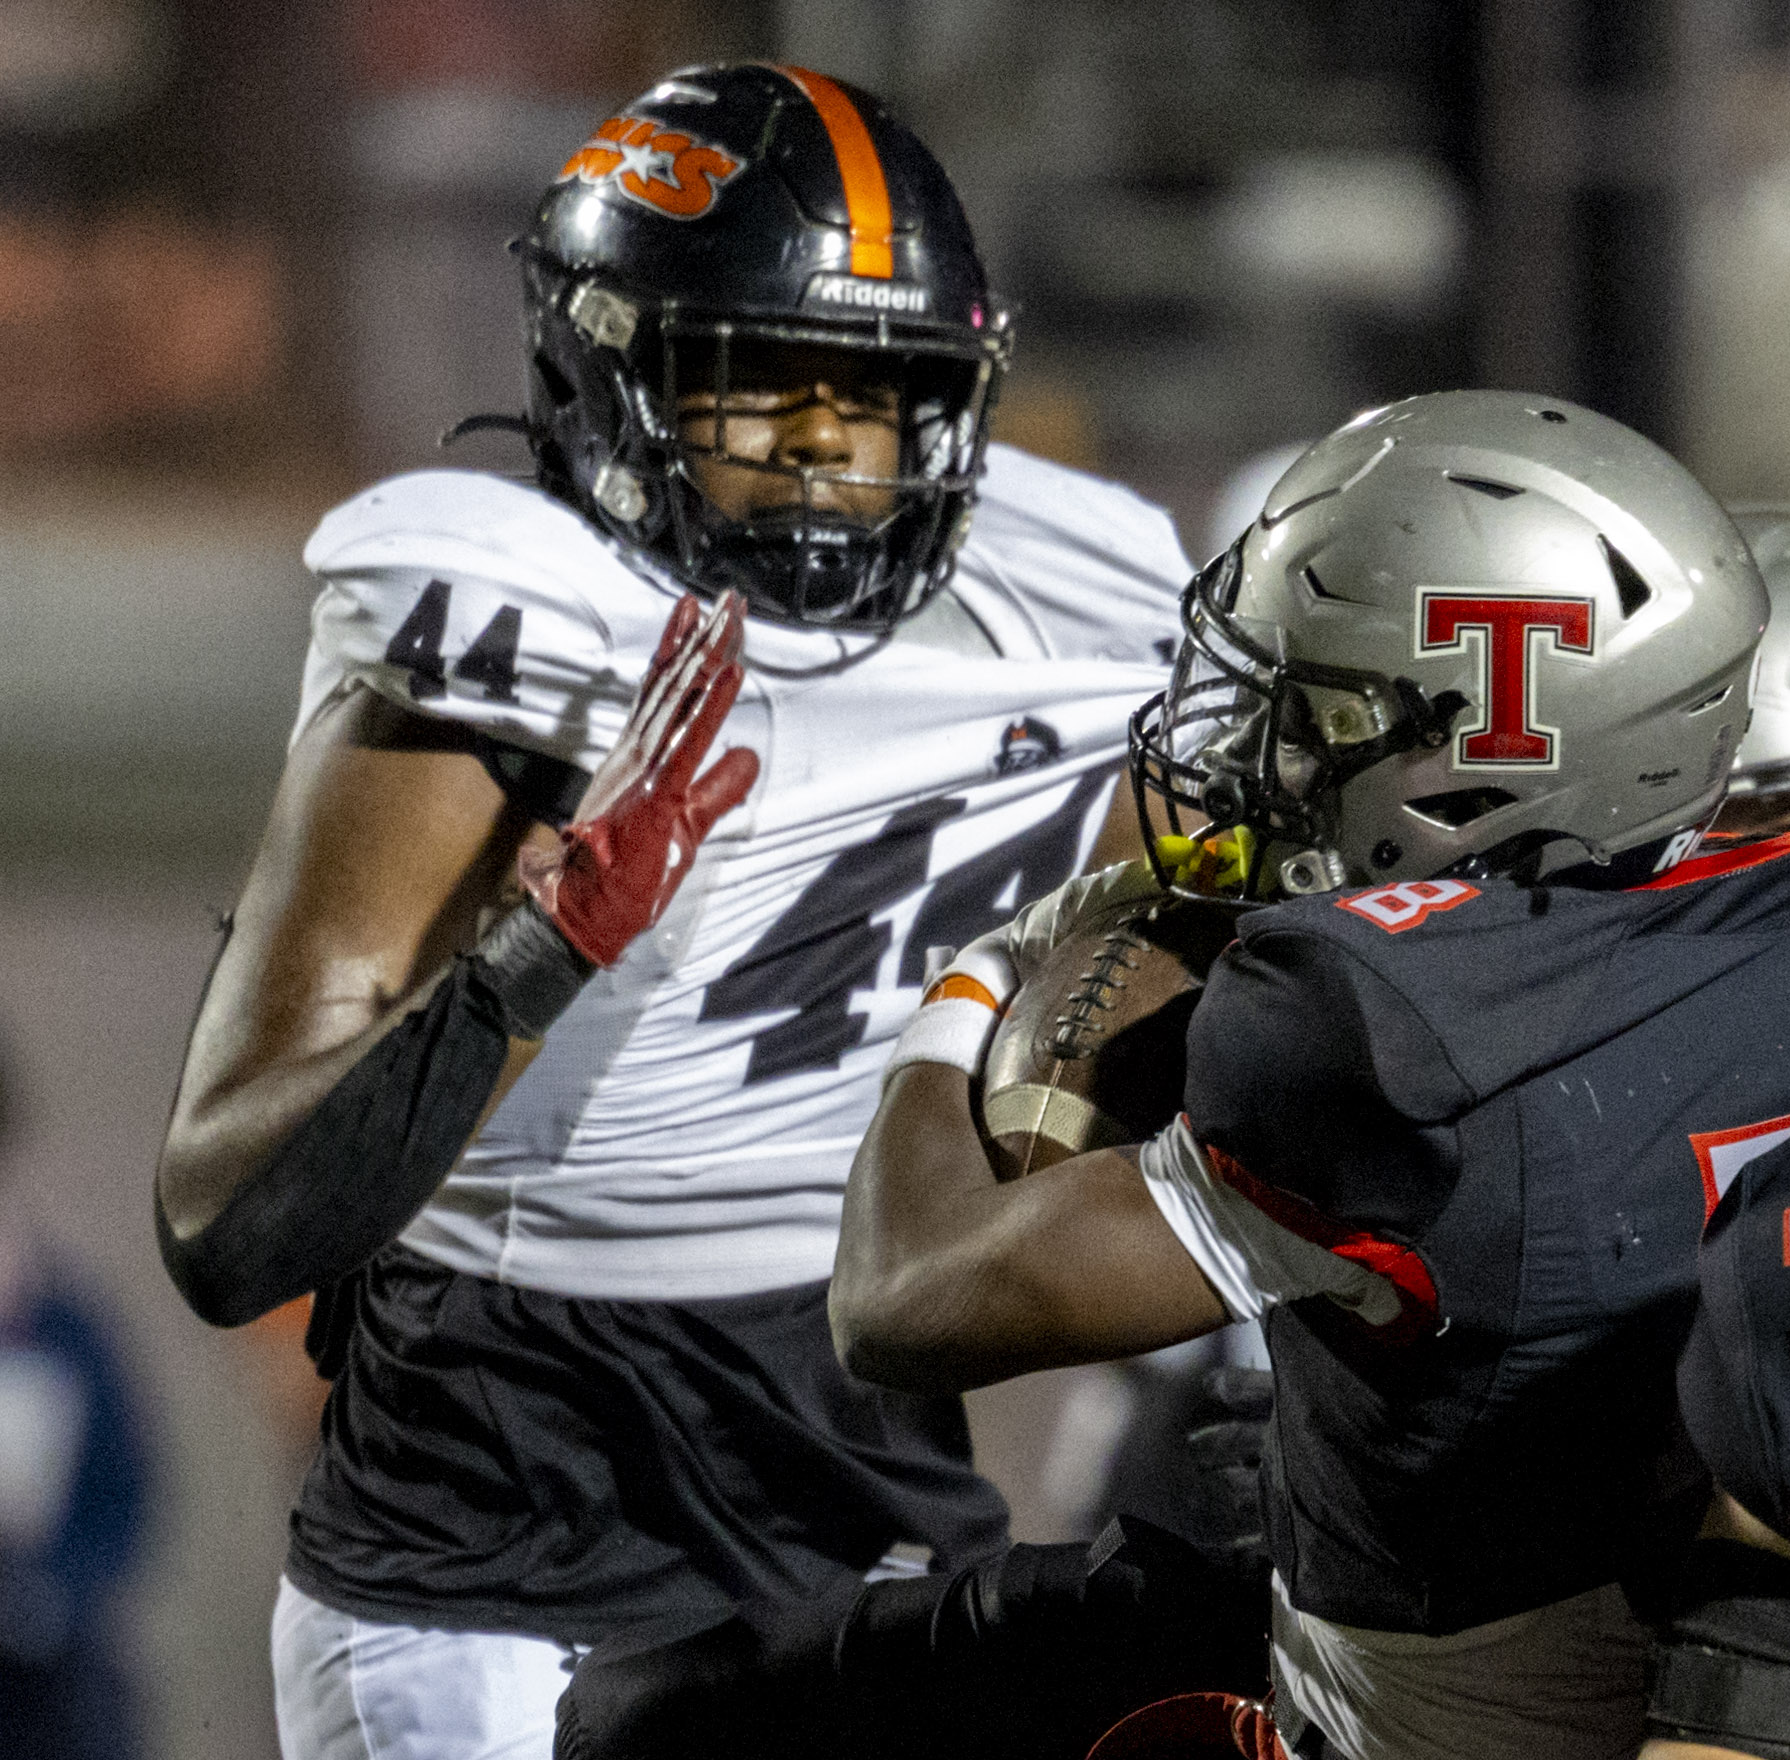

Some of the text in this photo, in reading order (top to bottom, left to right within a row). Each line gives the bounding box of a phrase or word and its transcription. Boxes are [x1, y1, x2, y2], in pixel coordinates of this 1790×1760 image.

[821, 277, 926, 312] Riddell
[384, 578, 523, 706] 44
[1414, 586, 1598, 773] T
